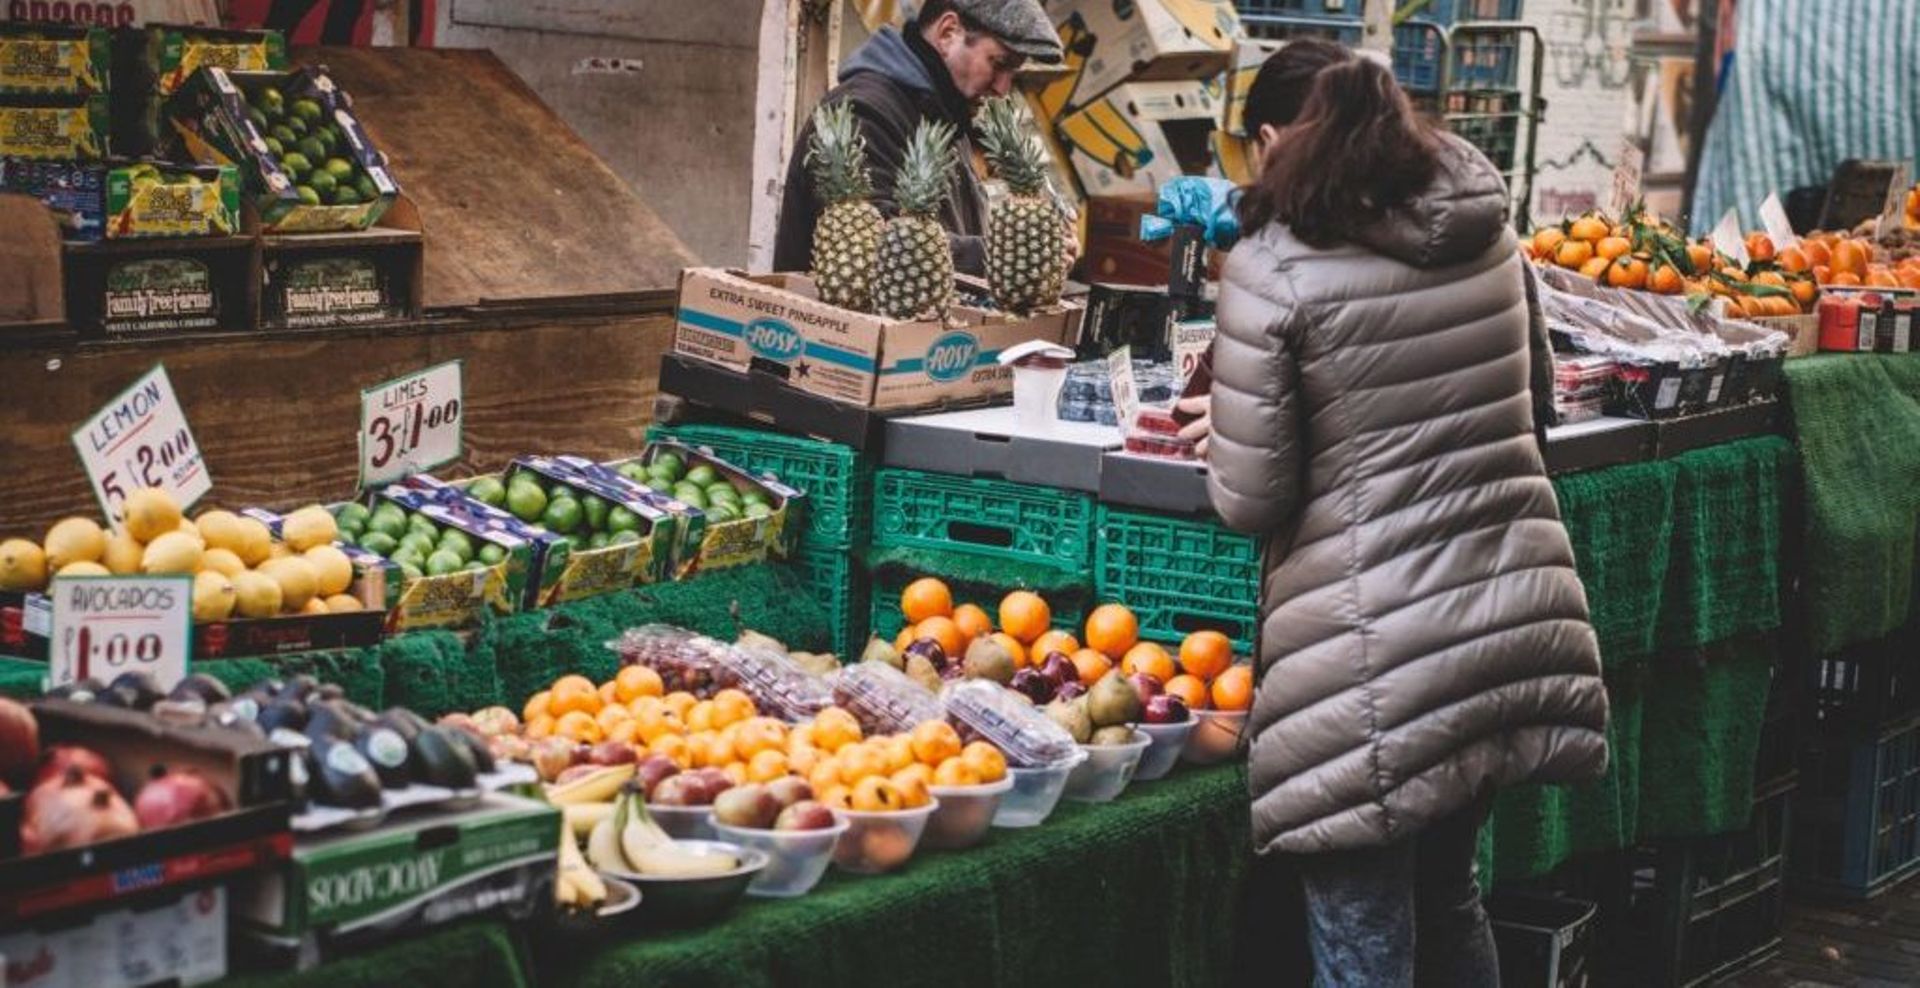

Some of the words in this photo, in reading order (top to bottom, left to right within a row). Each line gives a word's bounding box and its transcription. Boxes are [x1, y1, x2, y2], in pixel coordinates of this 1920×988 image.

[709, 287, 745, 306] EXTRA
[747, 297, 785, 316] SWEET
[787, 307, 850, 334] PINEAPPLE
[89, 381, 160, 451] LEMON
[383, 378, 428, 408] LIMES
[71, 585, 175, 612] AVOCADOS
[307, 849, 444, 913] AVOCADOS
